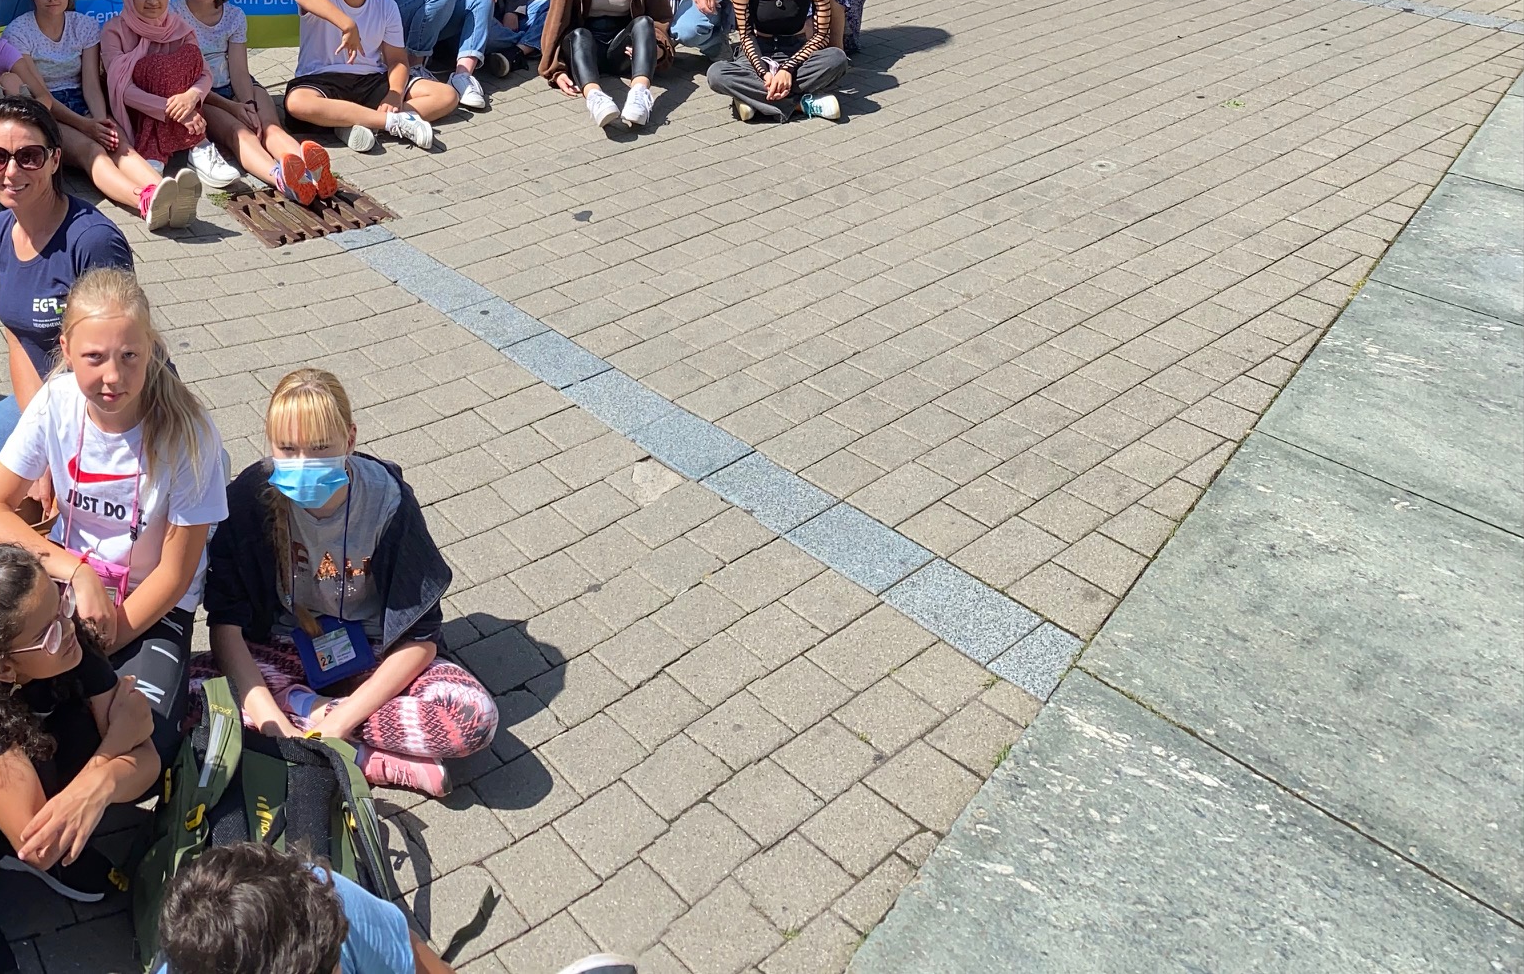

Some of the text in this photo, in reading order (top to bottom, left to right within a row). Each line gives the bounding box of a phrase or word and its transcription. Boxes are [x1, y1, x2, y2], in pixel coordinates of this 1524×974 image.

[66, 489, 126, 520] JUST DO
[320, 654, 333, 667] 22
